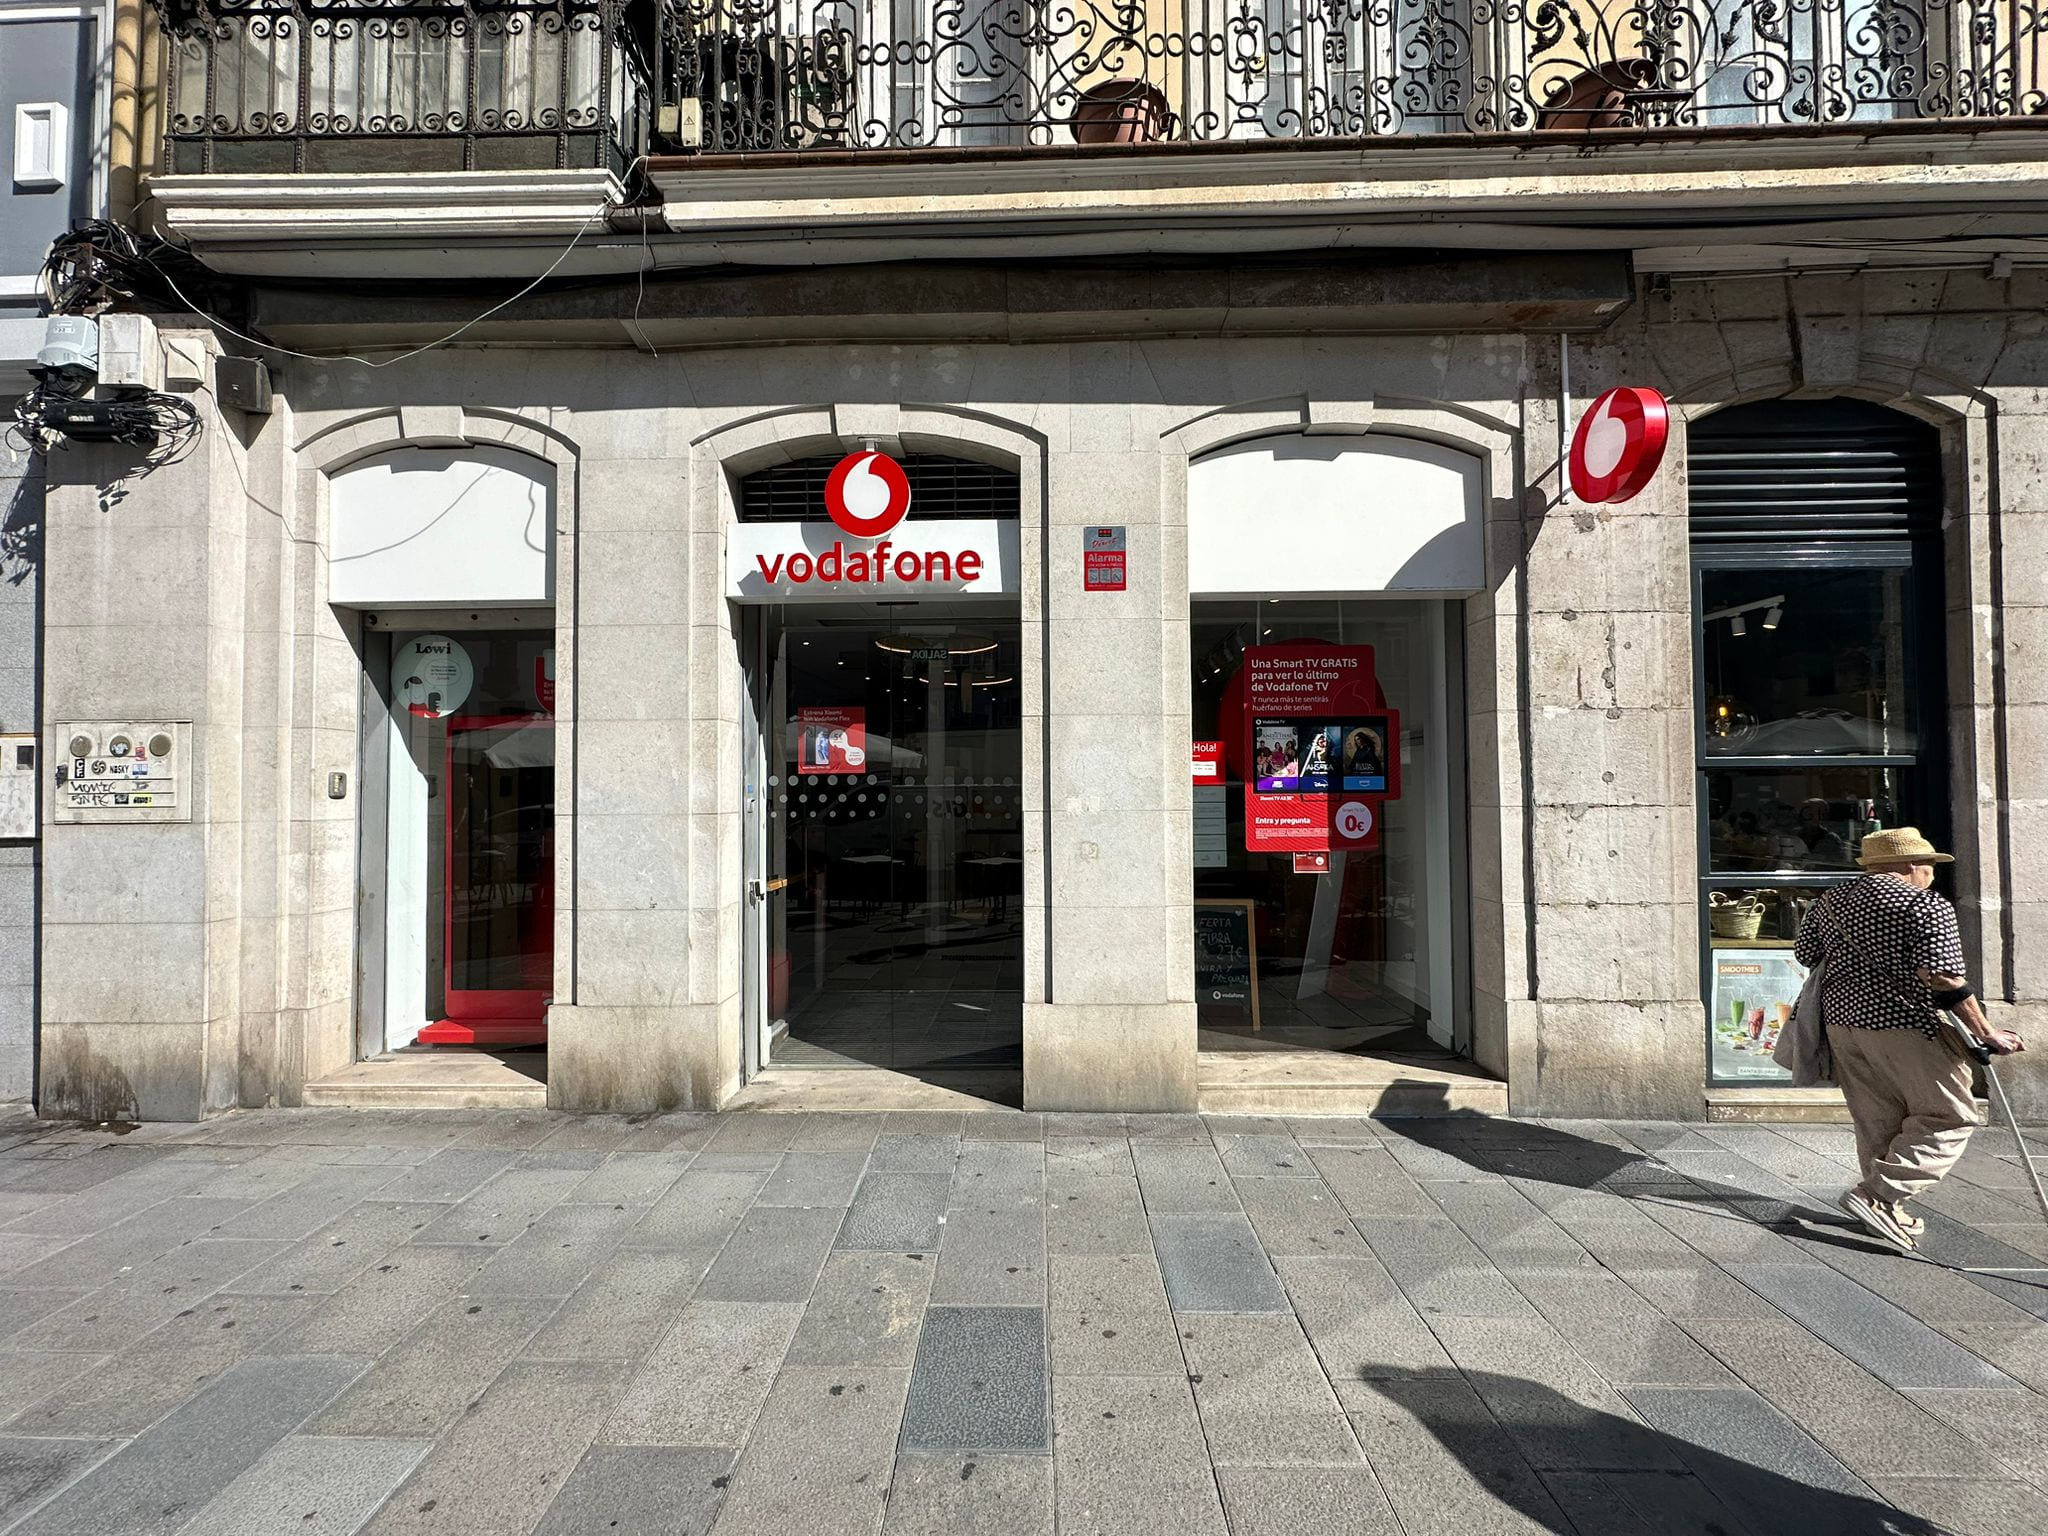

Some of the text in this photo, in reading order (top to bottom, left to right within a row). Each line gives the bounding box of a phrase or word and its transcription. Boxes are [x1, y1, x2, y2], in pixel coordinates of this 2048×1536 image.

[756, 541, 983, 584] vodafone
[1088, 553, 1123, 562] Alarma
[415, 642, 451, 654] Lowi
[1251, 658, 1358, 668] Una Smart TV GRATIS
[1251, 672, 1273, 681] para
[1294, 671, 1304, 679] lo
[1306, 670, 1339, 679] último
[1251, 682, 1329, 691] de Vodafone TV
[1193, 742, 1217, 753] Hola!
[1345, 815, 1364, 832] 0€
[1720, 965, 1760, 973] SMOOTHIES
